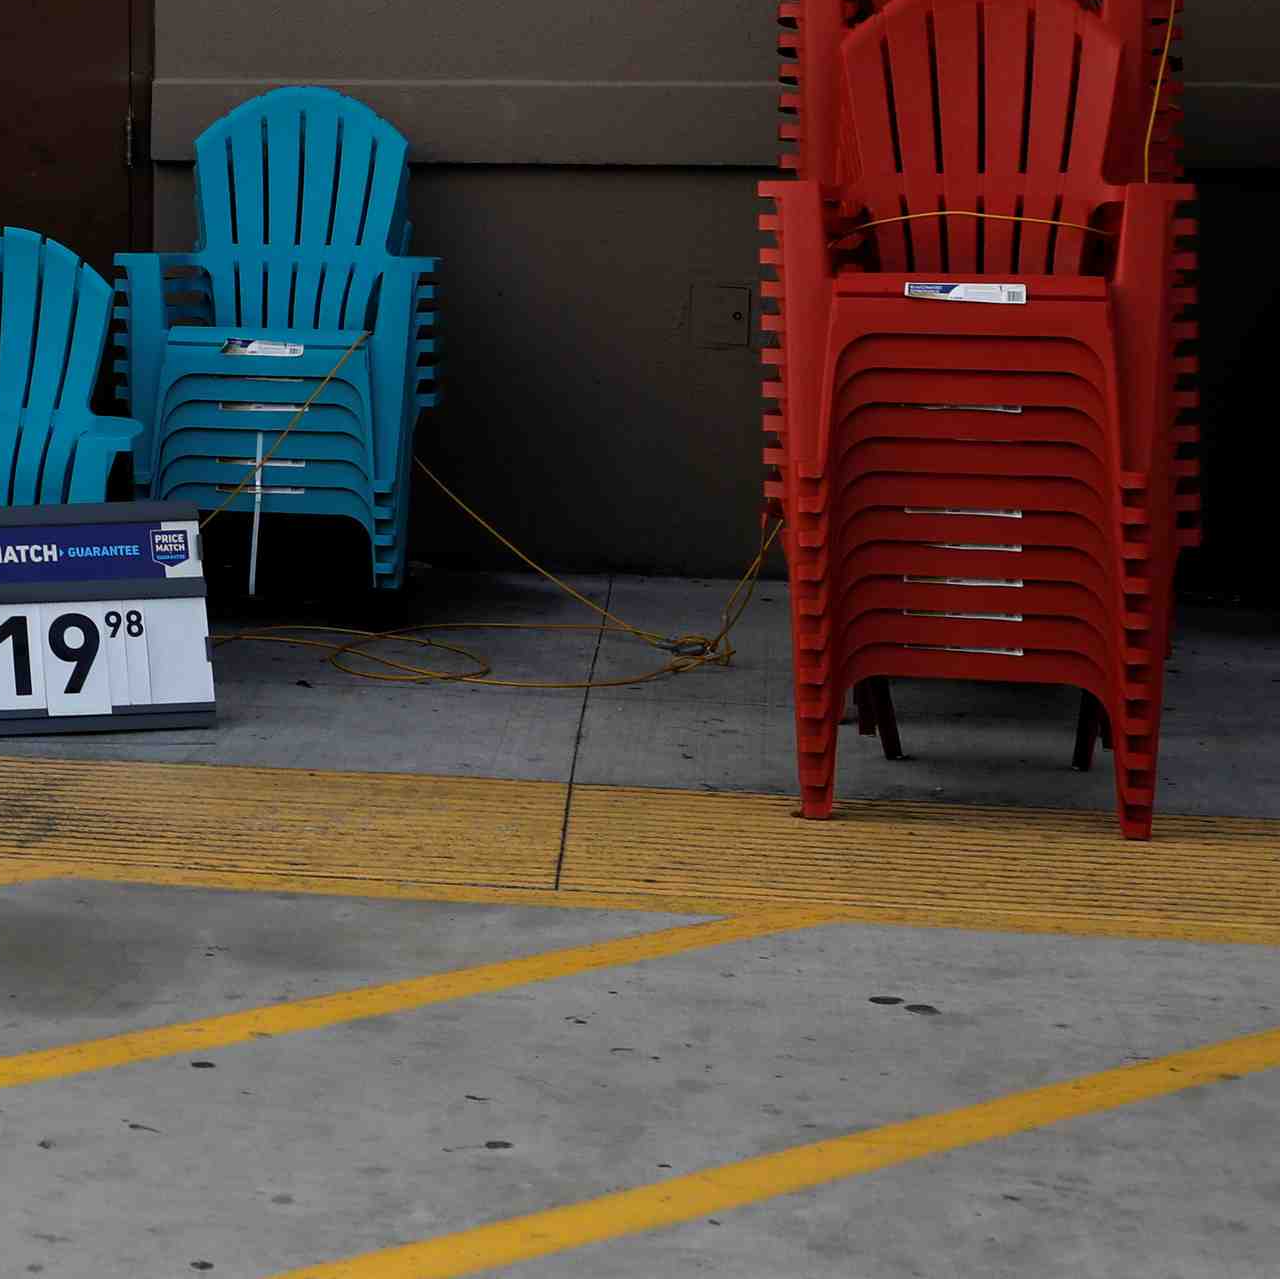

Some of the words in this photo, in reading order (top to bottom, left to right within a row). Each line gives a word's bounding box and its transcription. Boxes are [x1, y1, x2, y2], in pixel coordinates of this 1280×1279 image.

[155, 534, 184, 543] PRICE
[68, 545, 140, 558] GUARANTEE
[156, 543, 185, 552] MATCH
